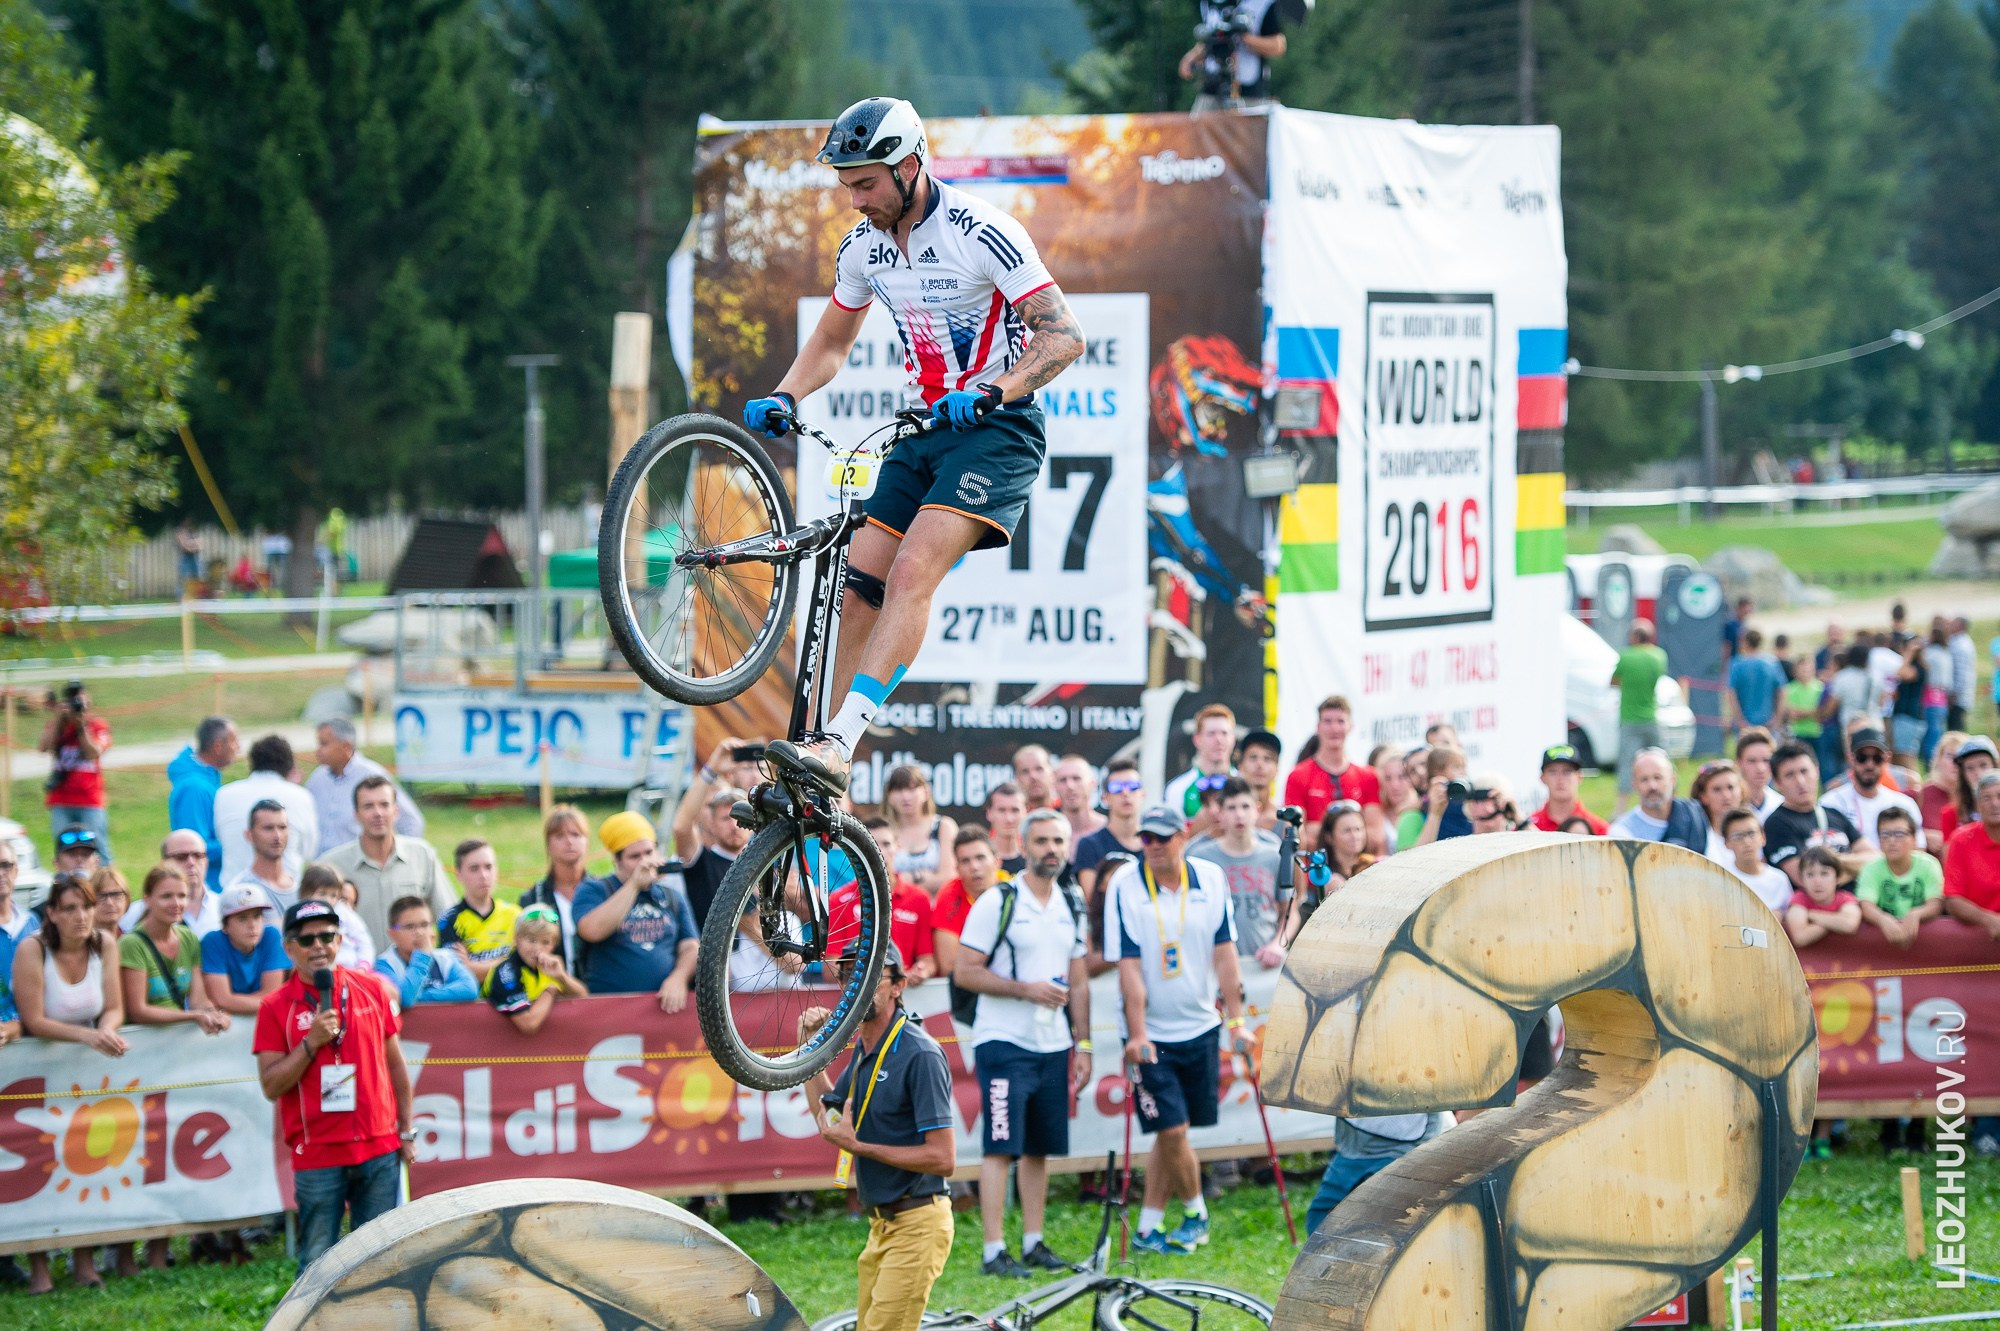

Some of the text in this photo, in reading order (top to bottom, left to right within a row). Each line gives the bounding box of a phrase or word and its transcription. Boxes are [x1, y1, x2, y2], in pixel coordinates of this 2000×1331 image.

[948, 208, 982, 236] sky
[868, 243, 899, 268] sky
[918, 256, 939, 264] adidas
[828, 390, 1117, 418] WOR NALS
[1378, 359, 1483, 425] WORLD
[956, 471, 993, 506] 5
[1383, 497, 1480, 597] 2016
[835, 548, 849, 618] JEALOUSY
[1027, 607, 1116, 643] AUG.
[872, 703, 1145, 731] SOLE TRENTINO ITALY
[463, 705, 584, 769] PEJO
[504, 1083, 578, 1157] di
[990, 1077, 1010, 1142] FRANCE
